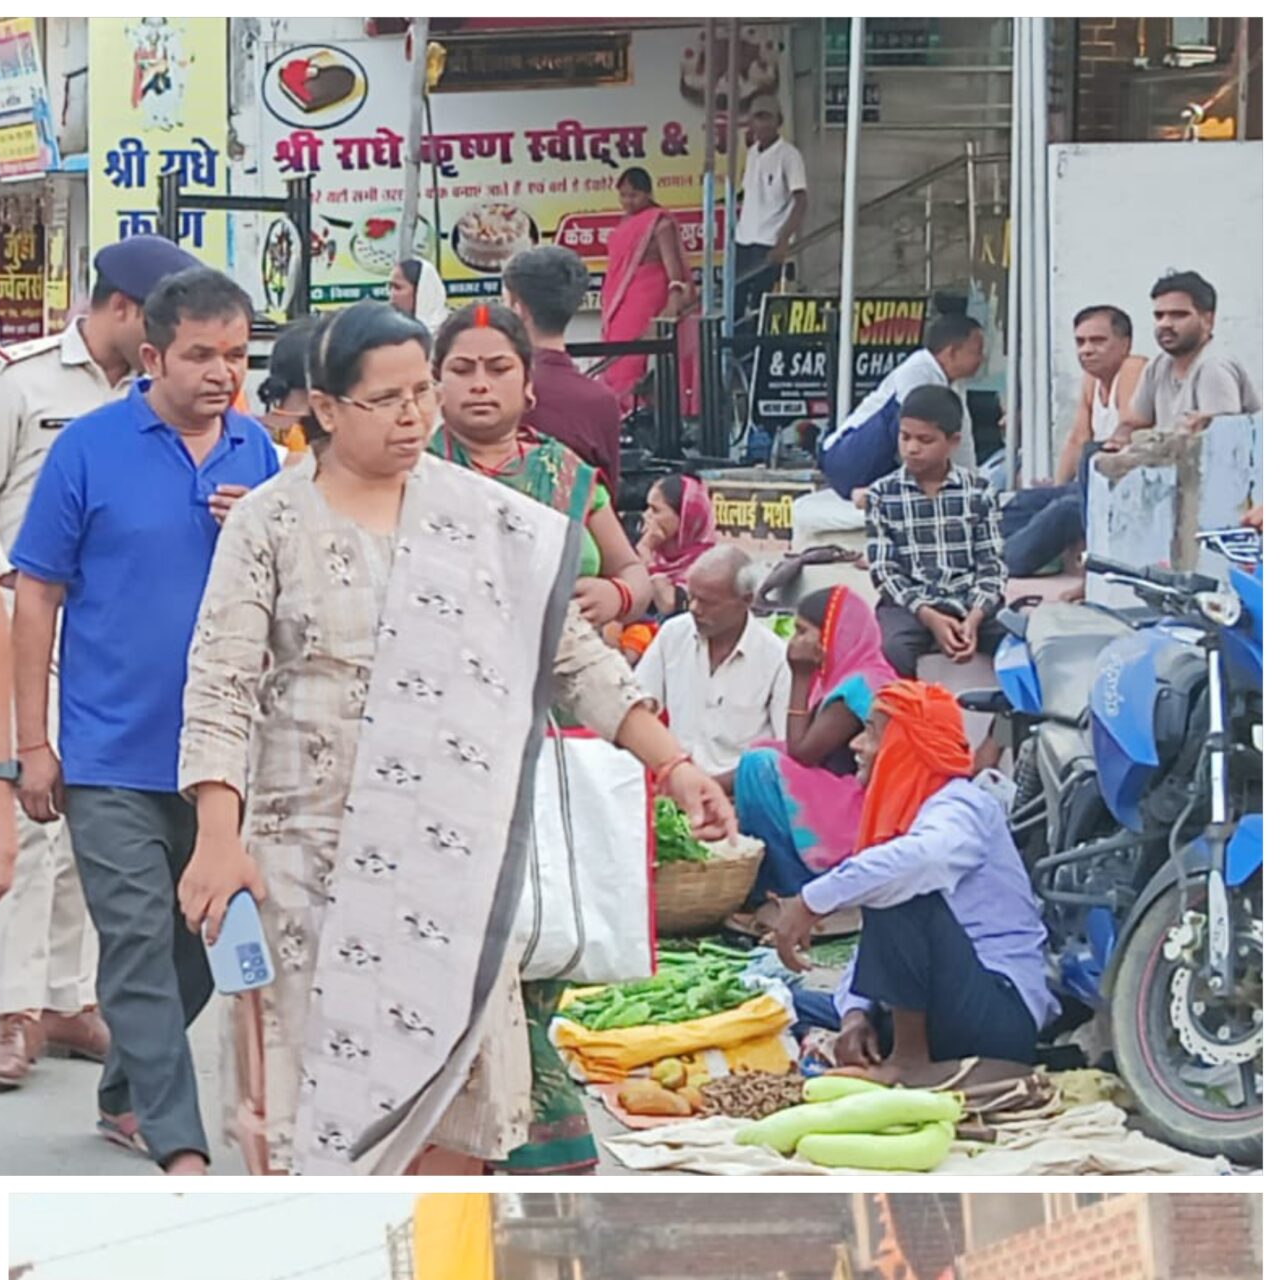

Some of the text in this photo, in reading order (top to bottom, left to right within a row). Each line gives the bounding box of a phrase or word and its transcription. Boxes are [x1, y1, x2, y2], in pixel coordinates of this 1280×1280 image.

[104, 137, 150, 189] श्री
[273, 127, 322, 173] श्री
[334, 126, 404, 171] राधे
[420, 130, 515, 178] कृष्ण
[661, 120, 690, 156] &
